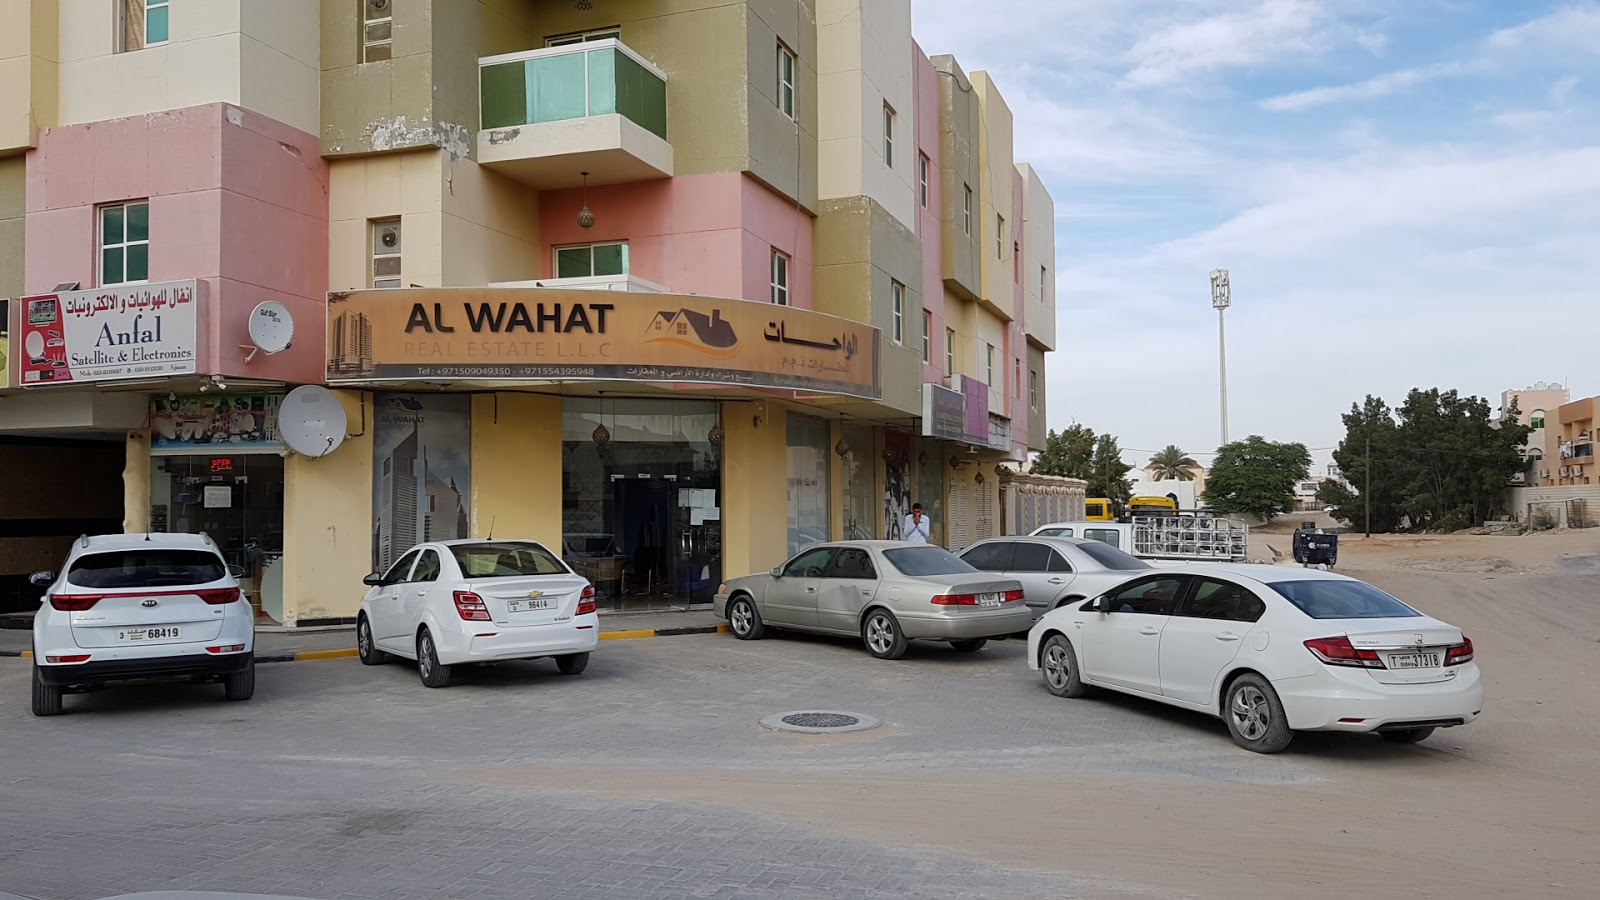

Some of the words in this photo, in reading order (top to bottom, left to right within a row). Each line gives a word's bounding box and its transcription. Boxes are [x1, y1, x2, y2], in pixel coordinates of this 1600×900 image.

[65, 293, 118, 317] الالكترونيات
[119, 298, 126, 314] و
[127, 288, 167, 312] للهوائيات
[169, 286, 192, 309] انفال
[404, 302, 455, 333] AL
[463, 302, 614, 334] WAHAT
[94, 314, 162, 347] Anfal
[763, 319, 858, 361] الواحات
[71, 350, 114, 366] Satellite
[117, 350, 128, 362] &
[132, 346, 192, 362] Electronics
[404, 342, 456, 357] REAL
[467, 341, 545, 357] ESTATE
[557, 342, 611, 358] L.L.C
[436, 367, 511, 375] +971509049350
[518, 367, 595, 376] +971554395948
[626, 367, 659, 377] العقارات
[393, 415, 426, 424] WAHAT
[148, 627, 179, 639] 68419
[1391, 656, 1397, 667] T
[1413, 654, 1439, 667] 37318
